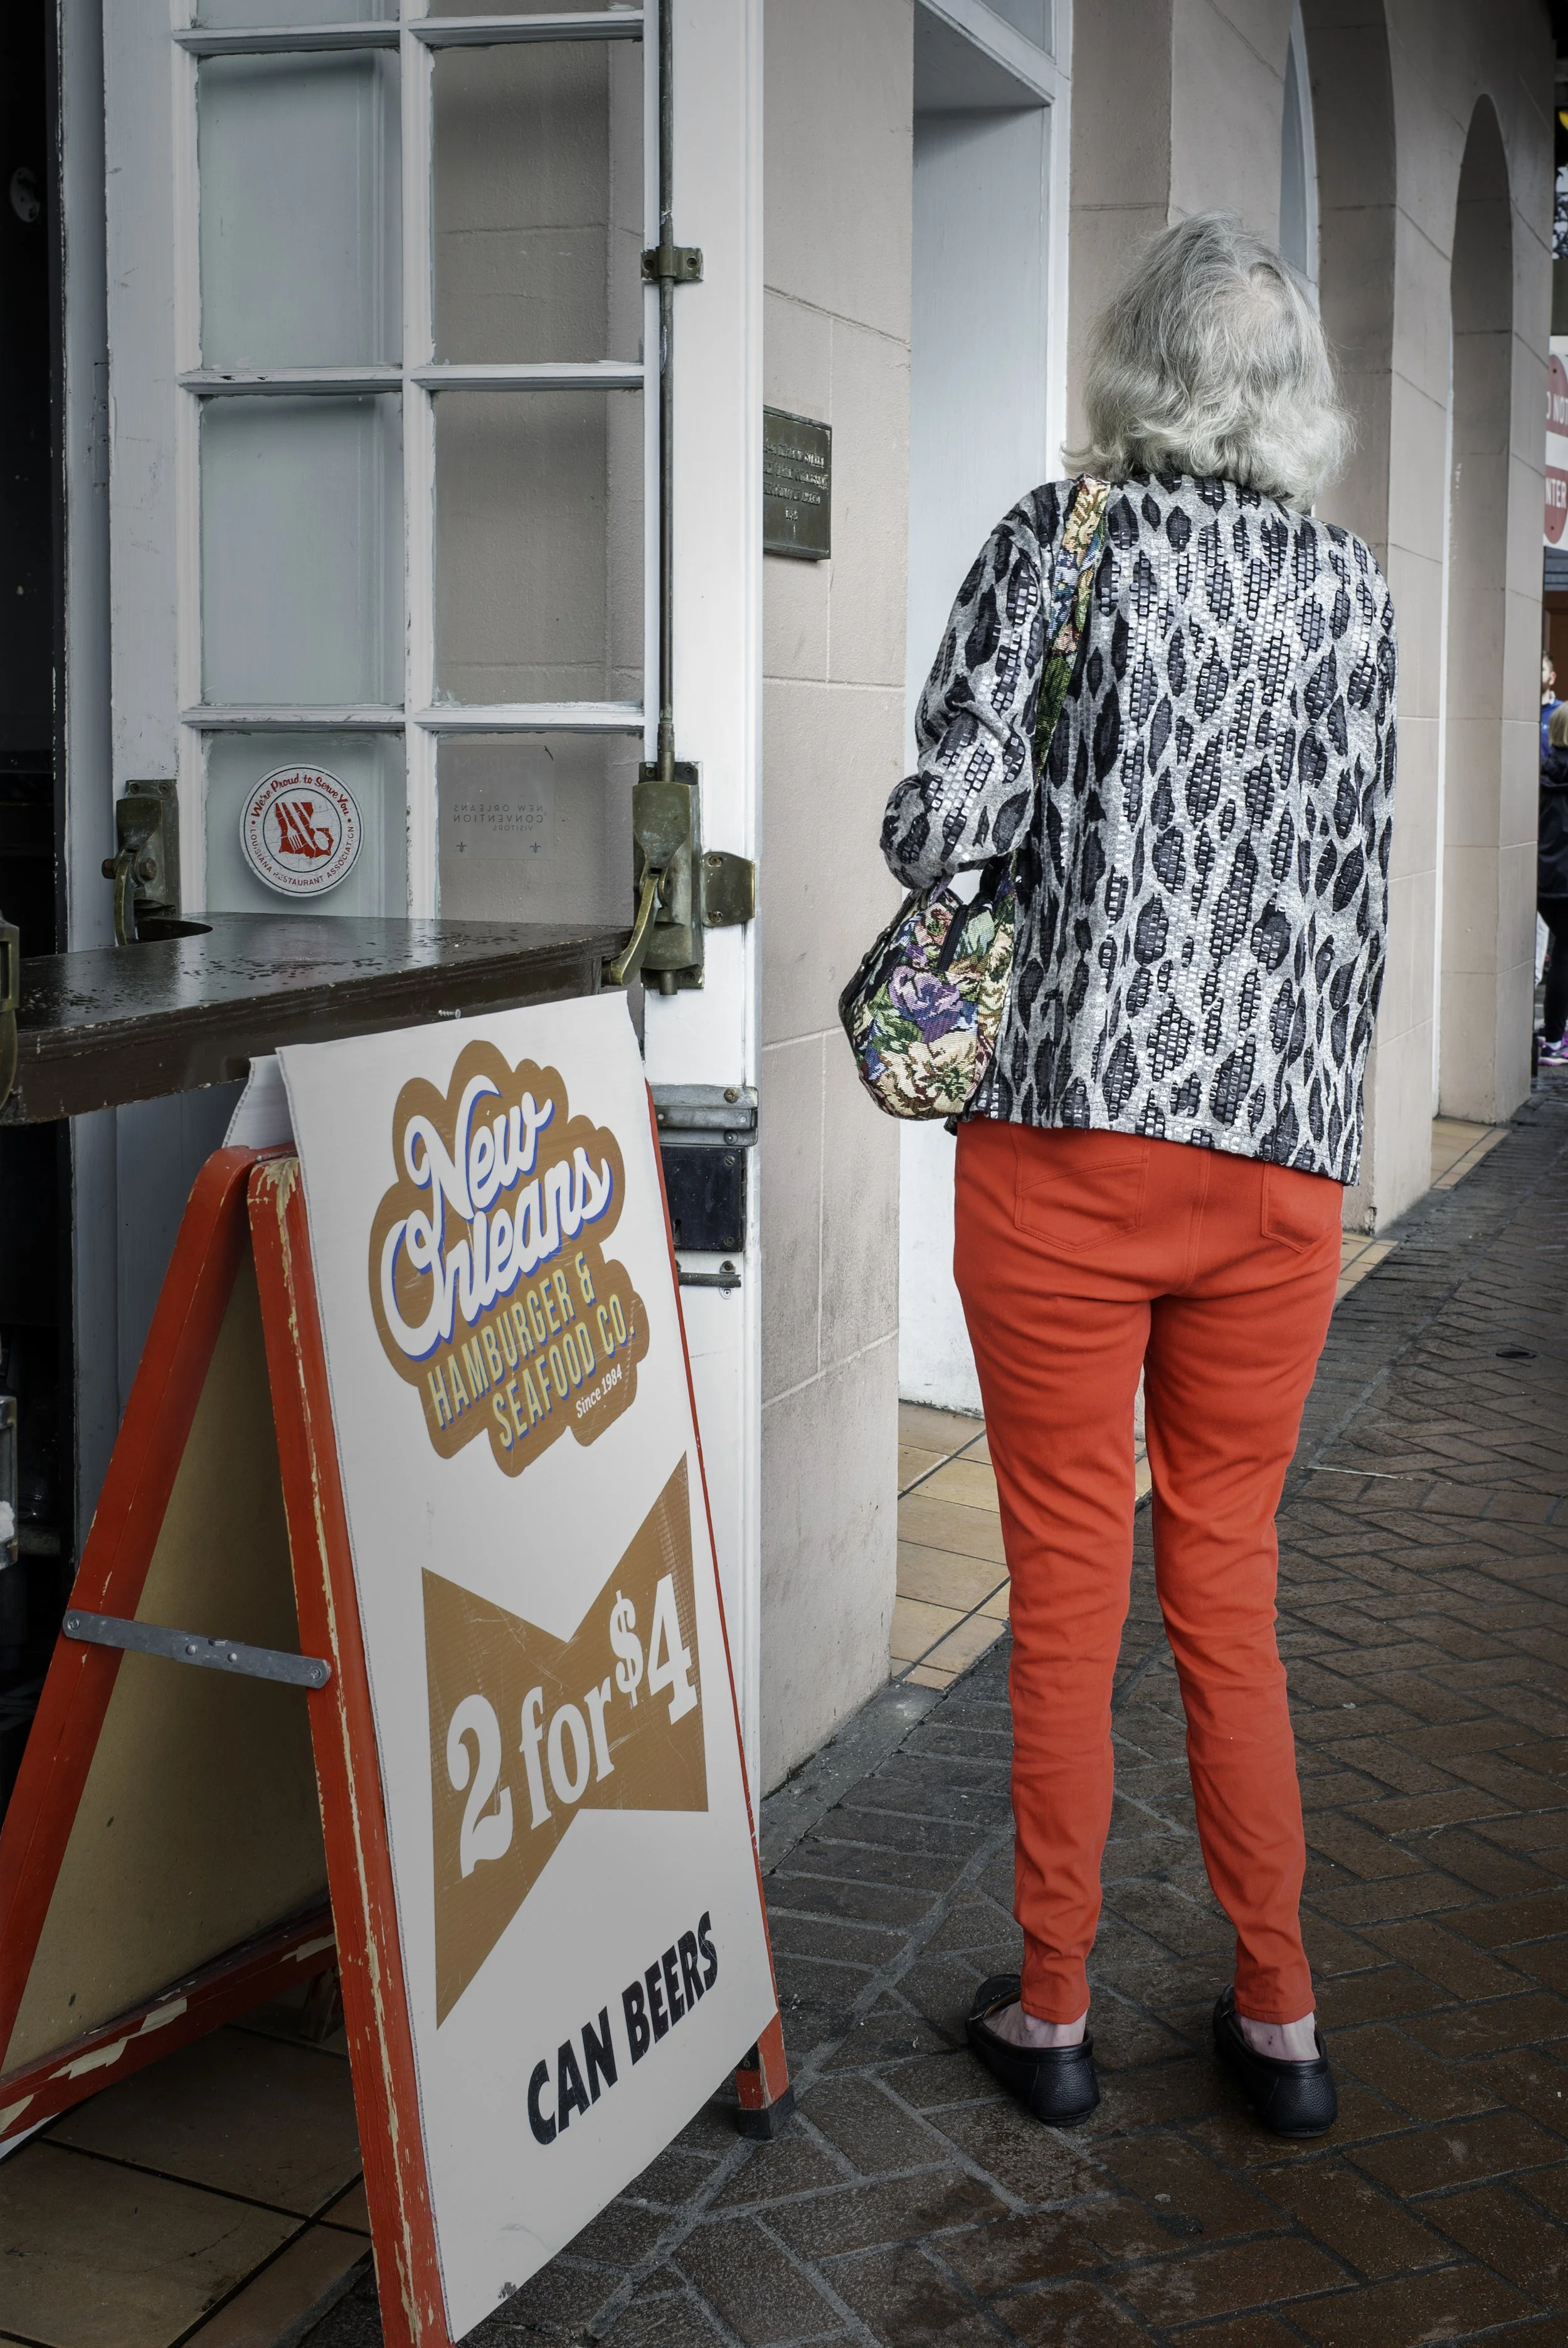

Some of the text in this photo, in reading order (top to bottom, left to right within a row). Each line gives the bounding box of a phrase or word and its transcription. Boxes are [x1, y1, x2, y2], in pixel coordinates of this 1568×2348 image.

[1553, 393, 1568, 425] NOT
[1545, 476, 1567, 509] NTER
[250, 829, 272, 873] LOUISIANA
[251, 773, 350, 817] We're Proud to Serve You
[403, 1074, 556, 1223] New
[381, 1146, 613, 1363] Orleans
[427, 1251, 596, 1431] HAMBURGER &
[492, 1294, 636, 1451] SEAFOOD CO.
[575, 1363, 623, 1418] Since 1984
[446, 1572, 698, 1879] 2 for $4
[527, 1911, 718, 2145] CAN BEERS
